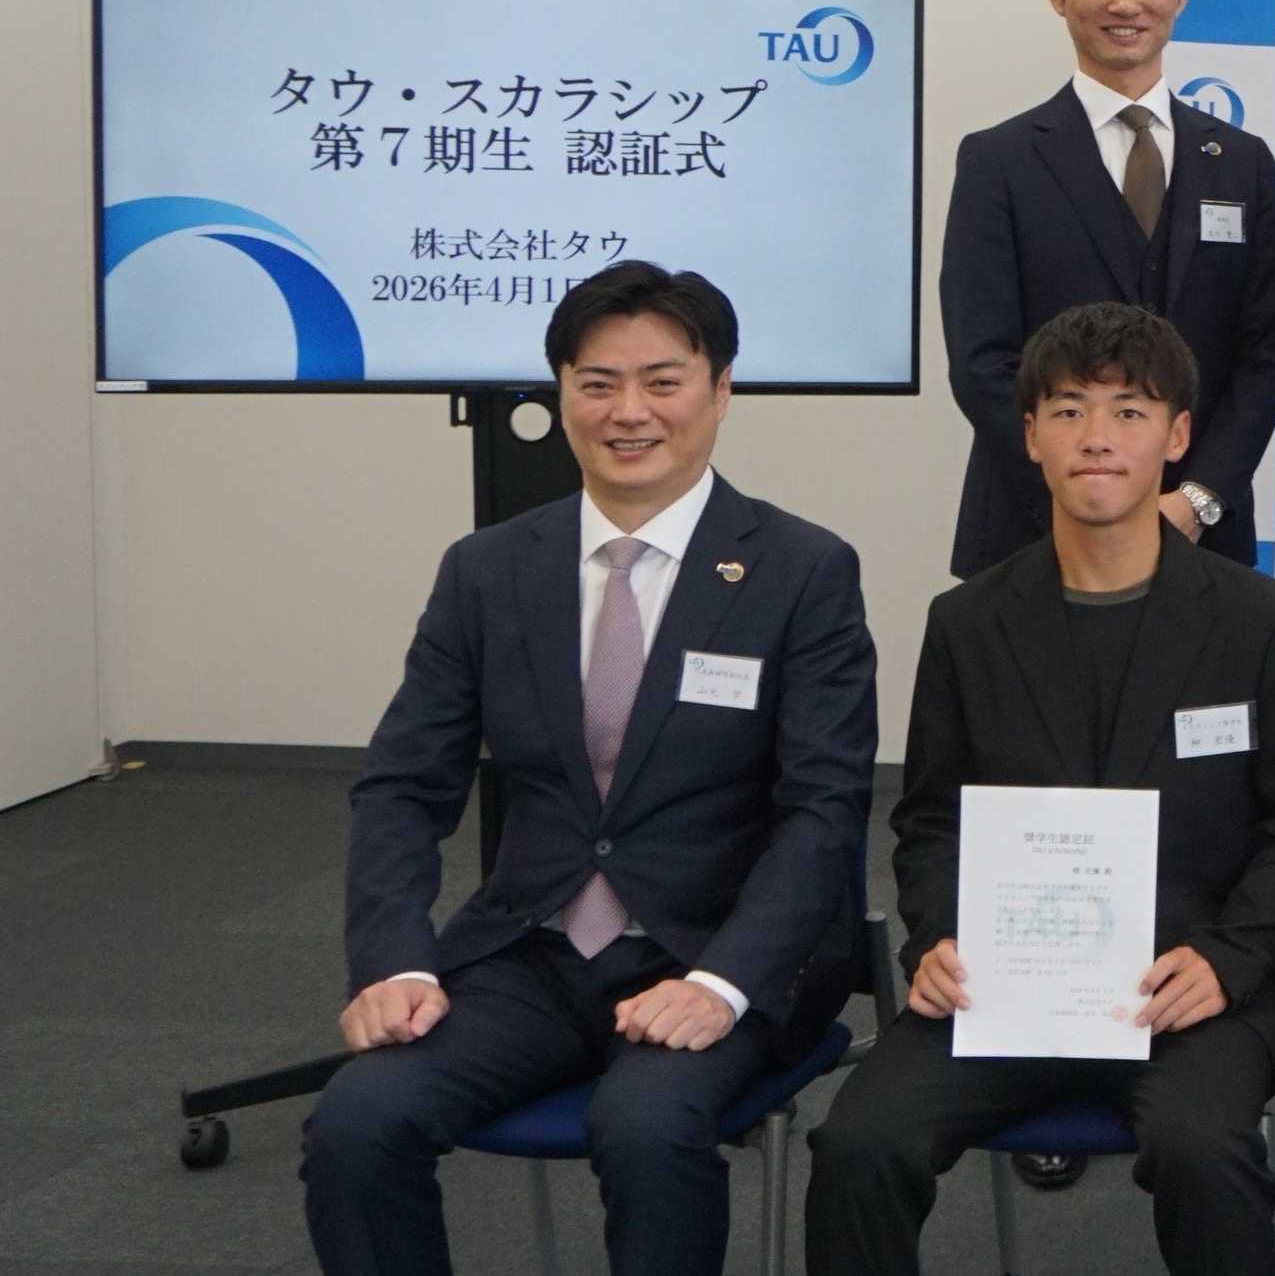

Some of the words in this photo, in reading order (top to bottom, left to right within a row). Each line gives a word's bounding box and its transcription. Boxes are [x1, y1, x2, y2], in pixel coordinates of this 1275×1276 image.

[758, 31, 840, 64] TAU
[271, 68, 768, 124] タウ・スカラシップ
[565, 129, 726, 178] 認証式
[411, 228, 627, 261] 株式会社タウ
